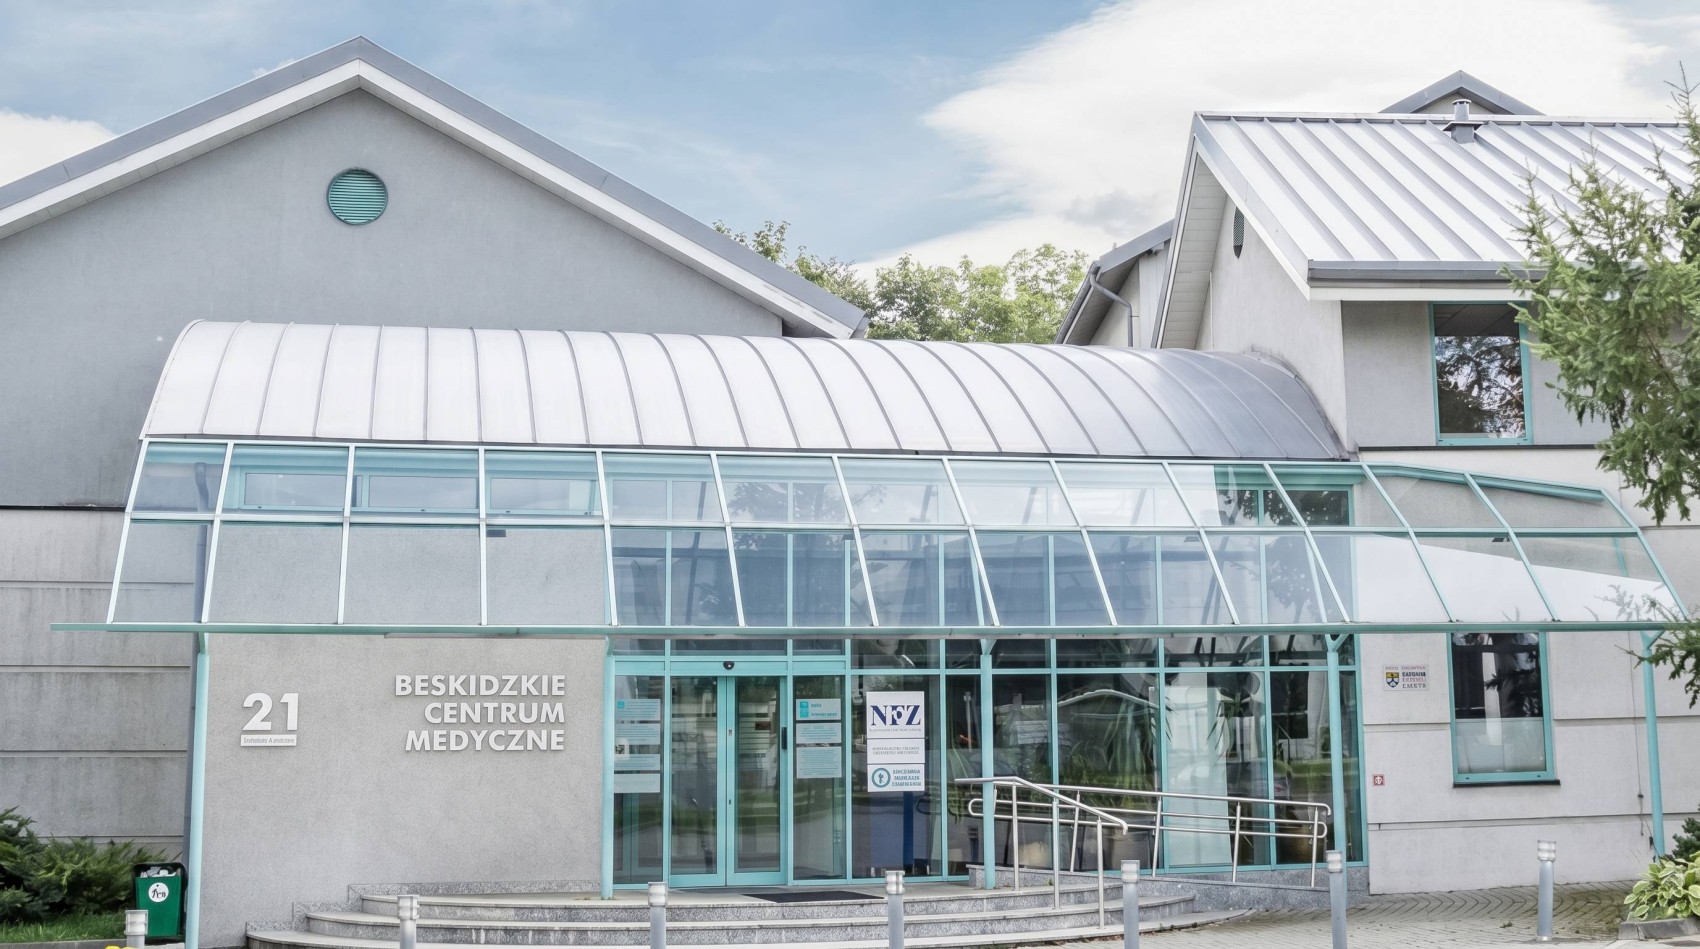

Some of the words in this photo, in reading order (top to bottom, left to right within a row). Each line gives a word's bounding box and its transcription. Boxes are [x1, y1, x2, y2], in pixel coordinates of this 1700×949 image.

[395, 675, 566, 696] BESKIDZKIE
[242, 692, 299, 731] 21
[424, 702, 565, 724] CENTRUM
[870, 704, 922, 726] NFZ
[405, 729, 565, 751] MEDYCZNE
